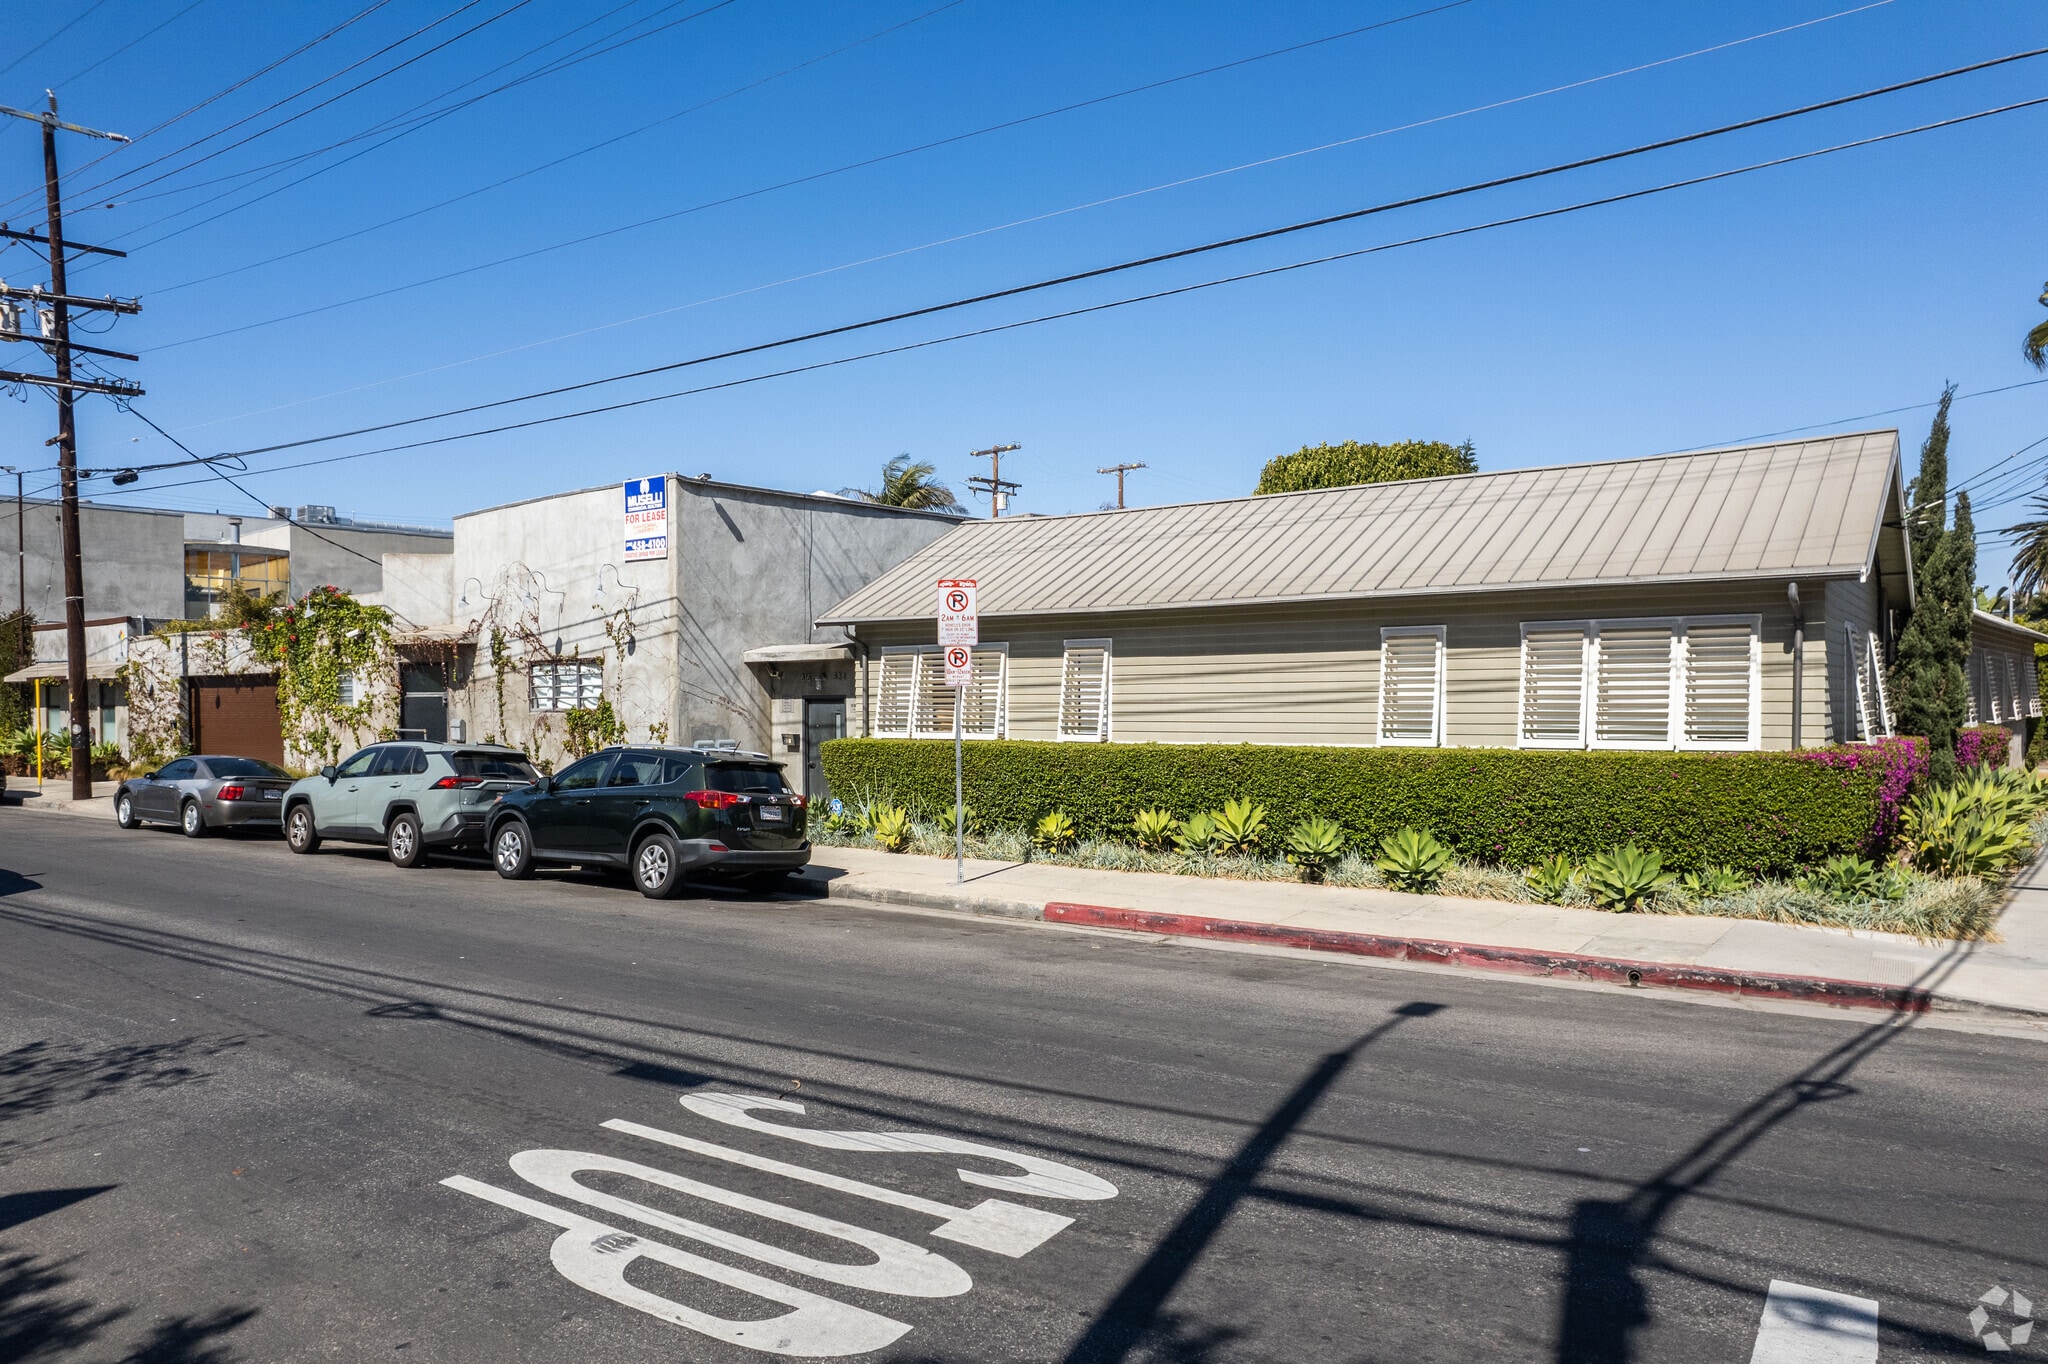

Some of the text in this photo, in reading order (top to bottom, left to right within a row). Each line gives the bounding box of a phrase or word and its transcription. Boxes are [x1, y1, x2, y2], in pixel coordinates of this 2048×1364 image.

[627, 492, 663, 507] MUSELLI
[625, 510, 666, 525] FOR LEASE
[632, 538, 666, 551] 458-4100
[941, 613, 975, 622] 2AM 6AM
[438, 1091, 1120, 1358] STOP
